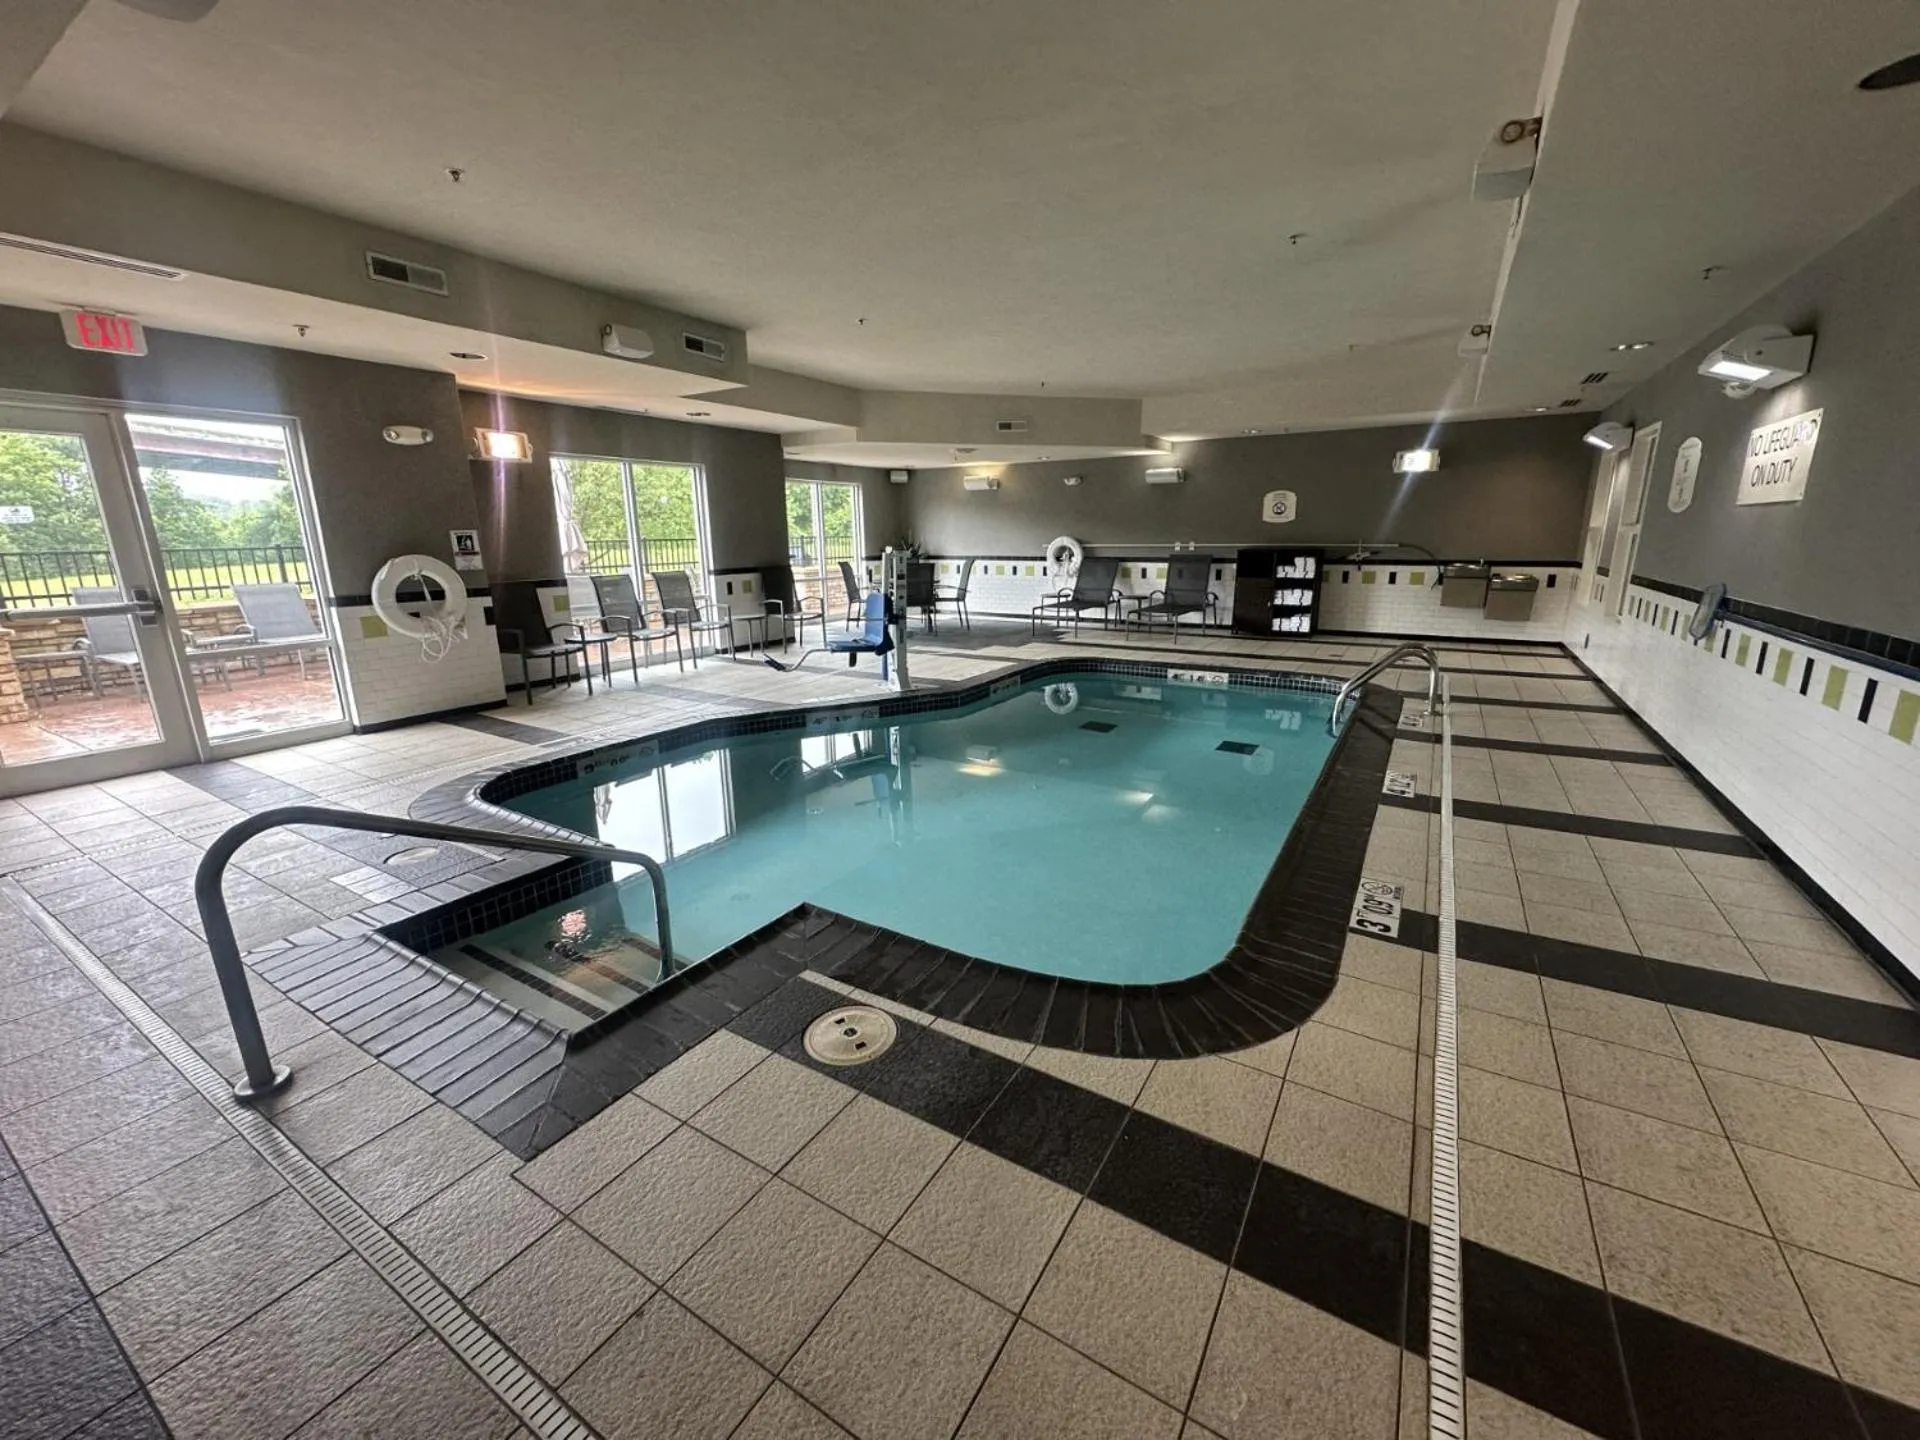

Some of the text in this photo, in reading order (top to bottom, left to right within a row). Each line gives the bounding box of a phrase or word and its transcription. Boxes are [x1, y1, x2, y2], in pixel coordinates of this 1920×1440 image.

[74, 312, 134, 351] EXIT
[1751, 457, 1799, 488] ON DUTY
